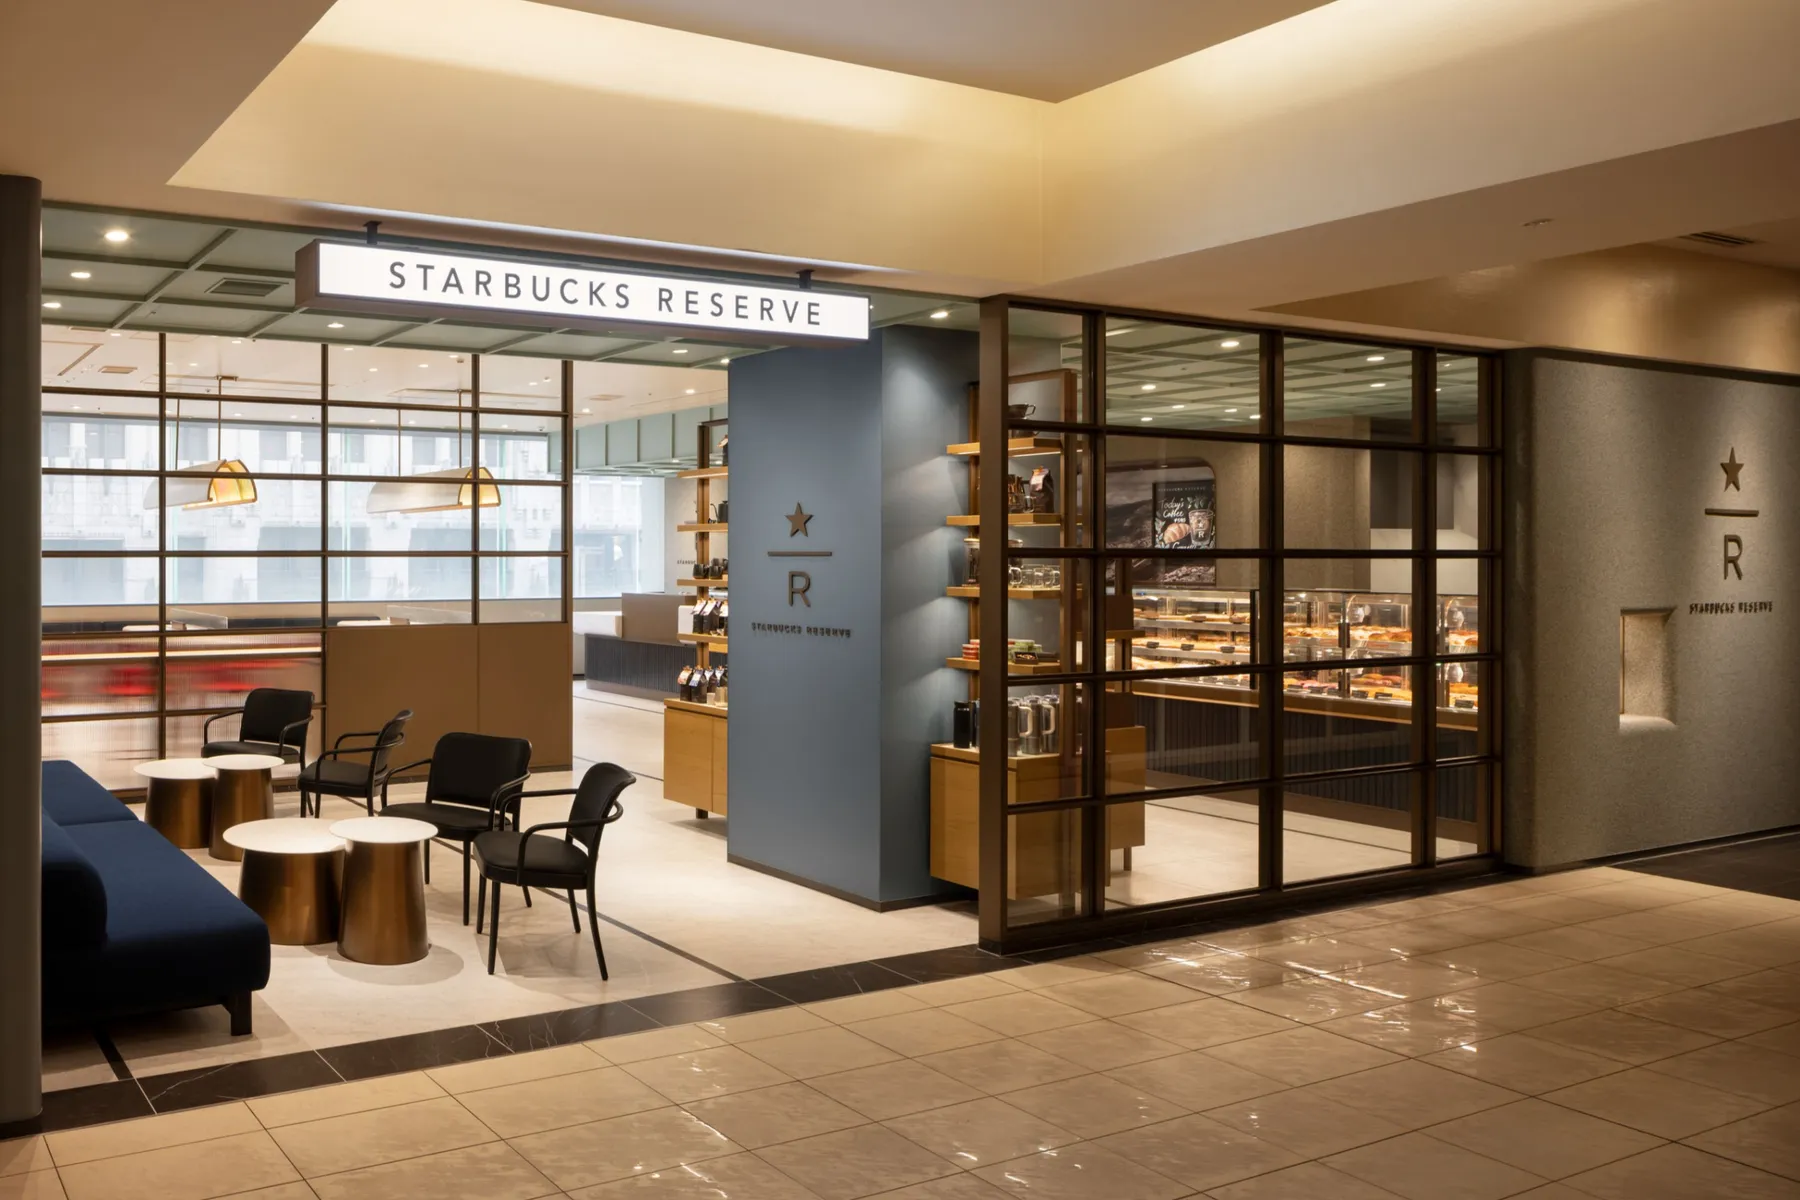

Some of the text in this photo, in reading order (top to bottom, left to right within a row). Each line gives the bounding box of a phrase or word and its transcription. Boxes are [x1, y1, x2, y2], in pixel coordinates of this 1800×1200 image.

[389, 261, 820, 326] STARBUCKS RESERVE
[1724, 534, 1743, 580] R
[788, 571, 811, 607] R
[1689, 601, 1772, 615] STARBUCKS RESERVE
[751, 622, 851, 638] STARBUCKS RESERVE
